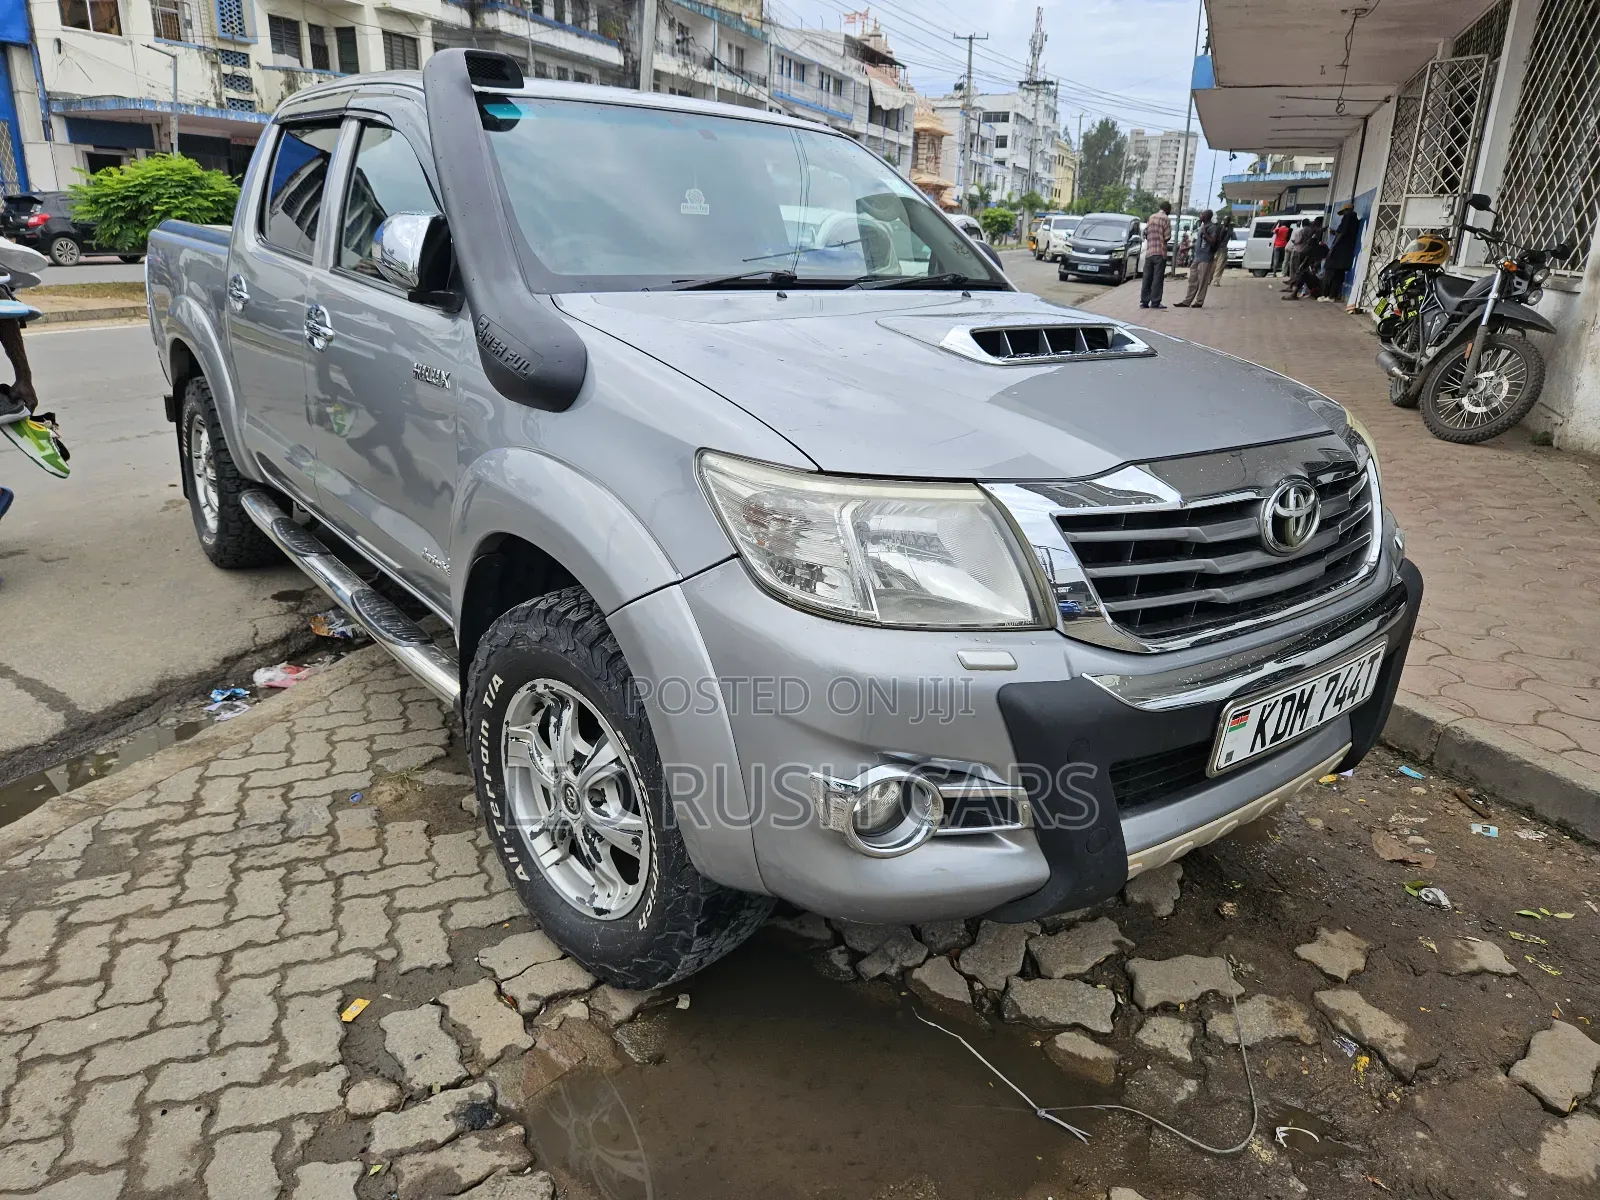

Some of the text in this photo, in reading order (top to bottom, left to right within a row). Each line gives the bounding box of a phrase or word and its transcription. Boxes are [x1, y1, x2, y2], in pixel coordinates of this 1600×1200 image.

[412, 362, 451, 390] HILUX
[504, 349, 531, 377] FUL
[1249, 651, 1381, 754] KDM 744T
[479, 673, 531, 882] All-Terrain T/A
